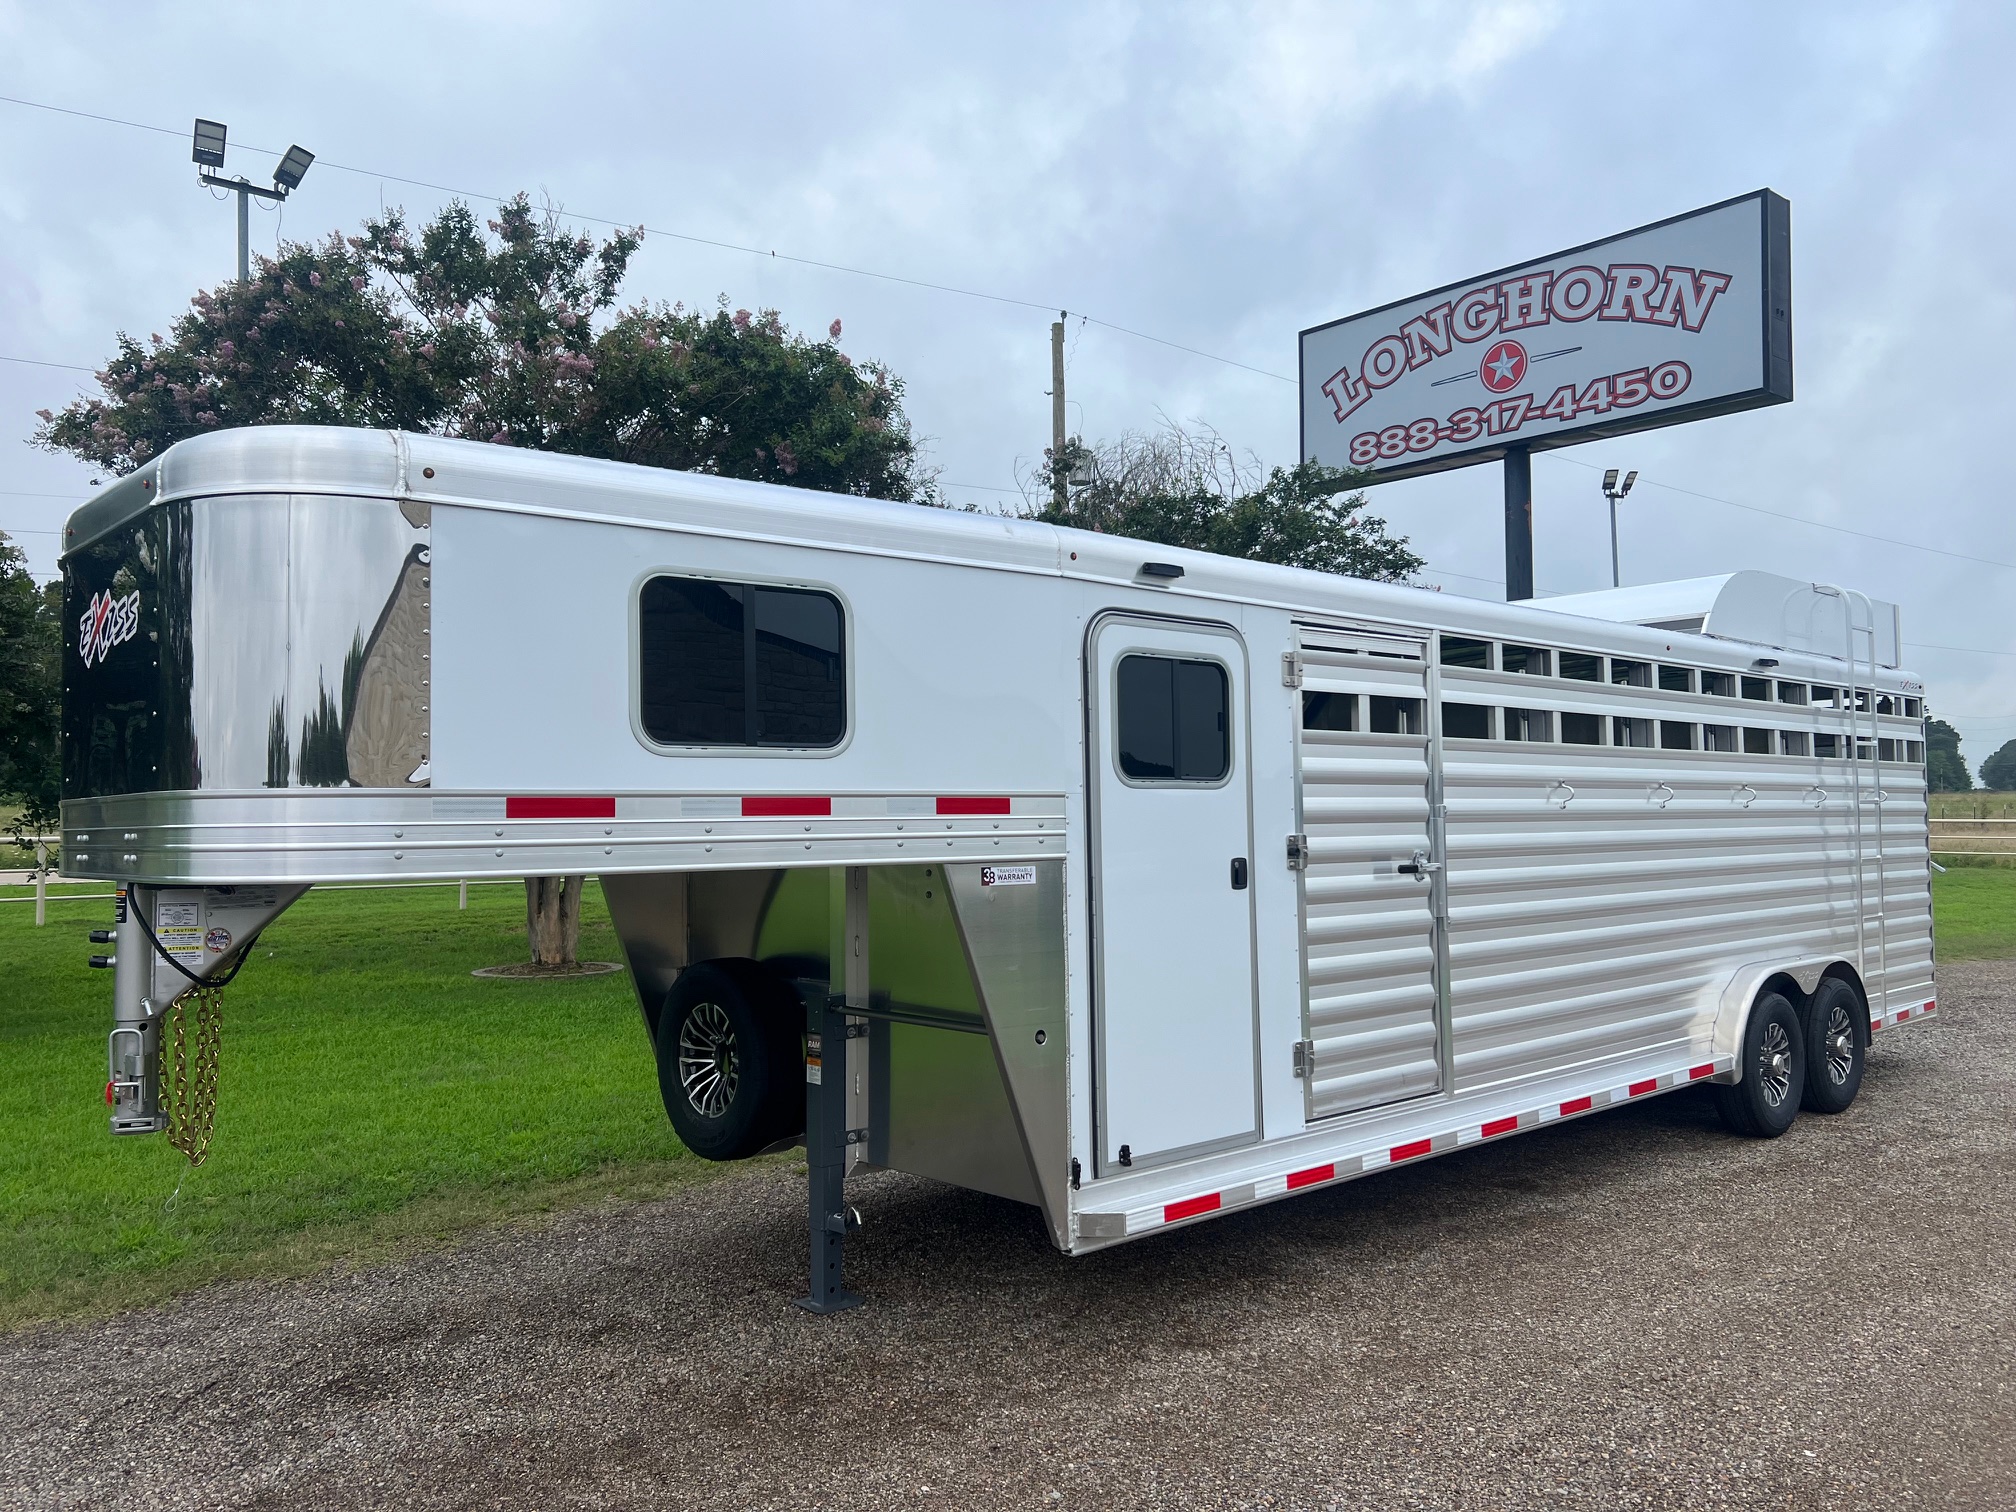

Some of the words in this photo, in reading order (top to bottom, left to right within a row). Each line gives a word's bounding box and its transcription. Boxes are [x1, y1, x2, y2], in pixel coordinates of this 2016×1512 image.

[1321, 263, 1732, 424] LONGHORN
[1349, 361, 1692, 466] 888-317-4450
[79, 588, 140, 669] EXISS
[983, 868, 996, 884] 38
[807, 1040, 820, 1048] RAM
